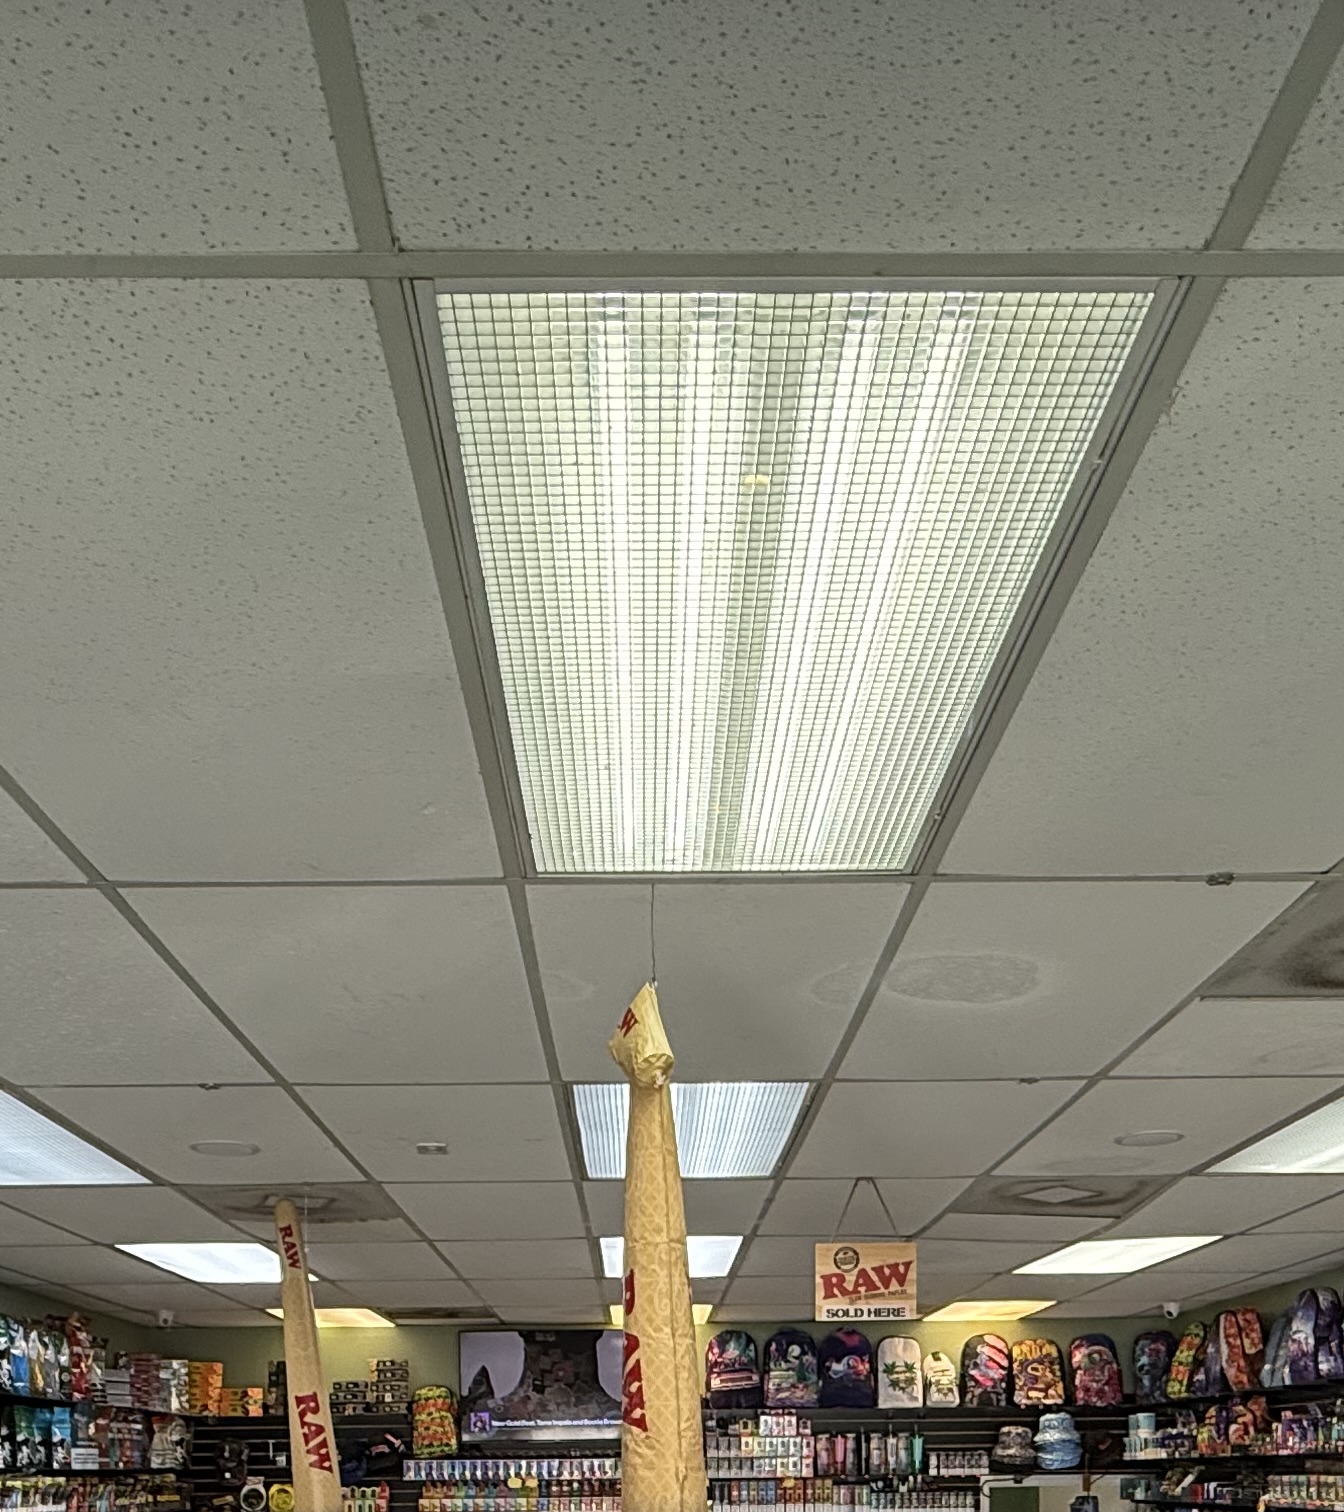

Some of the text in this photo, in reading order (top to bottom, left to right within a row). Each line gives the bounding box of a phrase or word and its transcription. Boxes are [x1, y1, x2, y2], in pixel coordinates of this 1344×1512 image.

[279, 1224, 302, 1270] RAW
[820, 1260, 914, 1300] RAW
[826, 1307, 906, 1318] SOLD HERE
[294, 1391, 333, 1474] RAW
